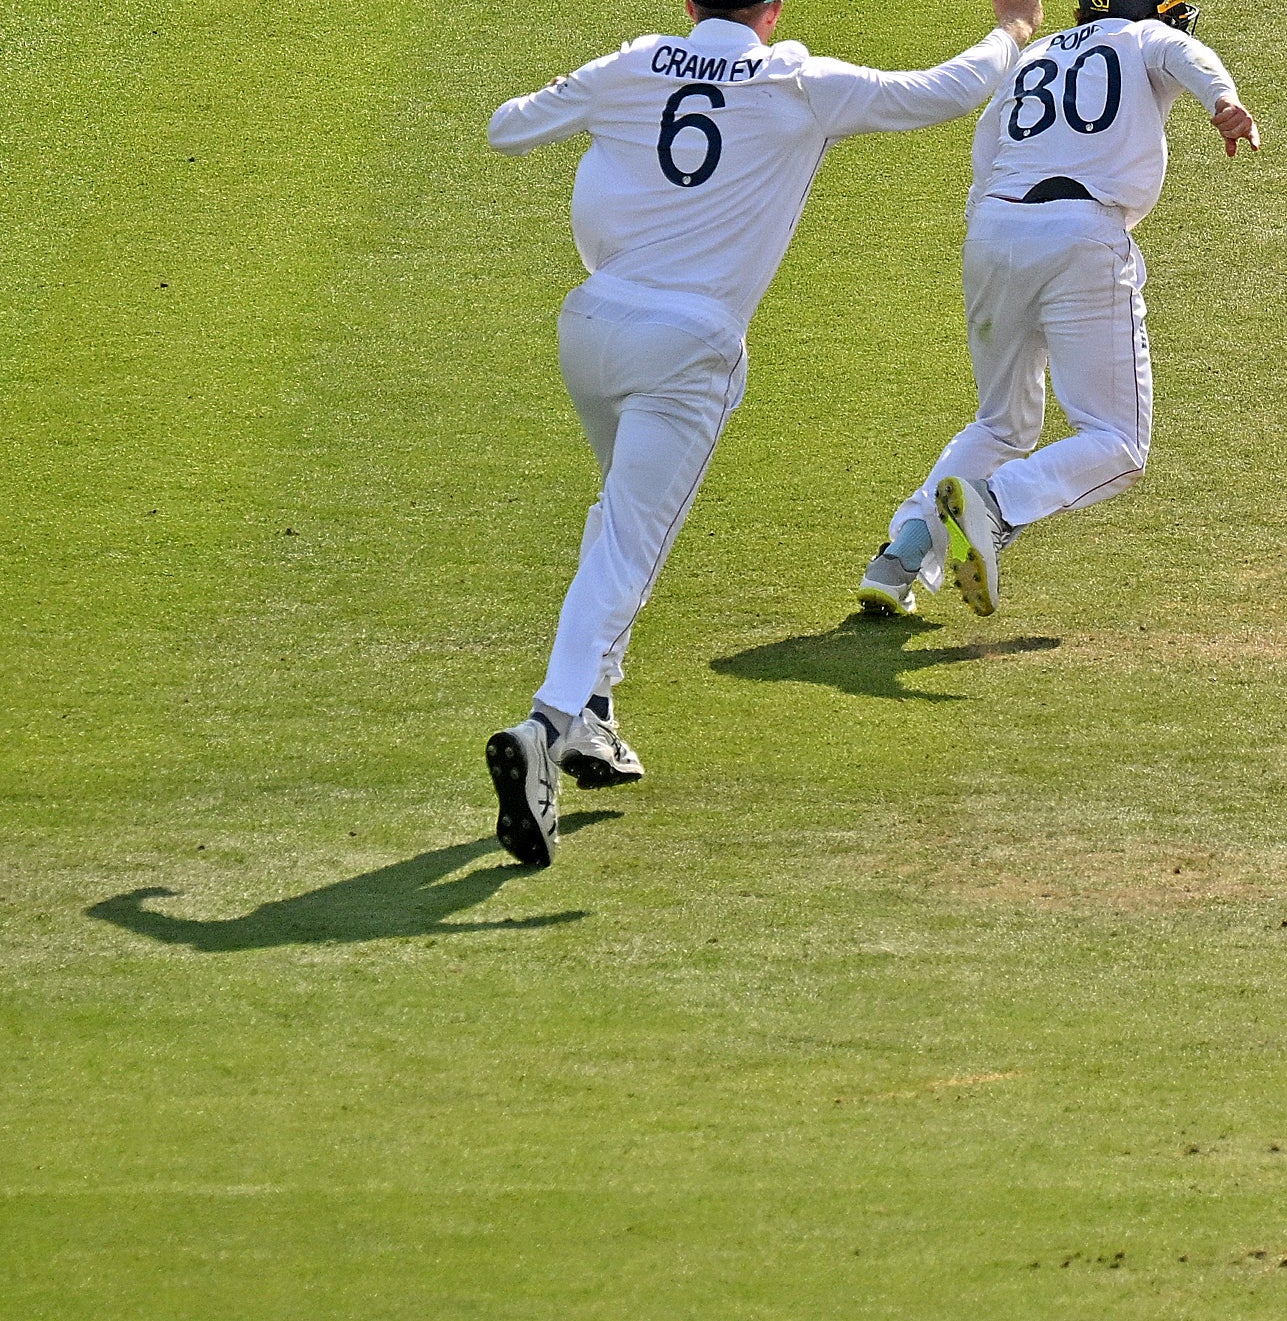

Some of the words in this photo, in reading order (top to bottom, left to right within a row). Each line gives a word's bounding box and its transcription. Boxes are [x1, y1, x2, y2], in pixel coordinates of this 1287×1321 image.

[651, 45, 763, 82] CRAWLEY
[1008, 45, 1122, 141] 80
[657, 83, 726, 188] 6
